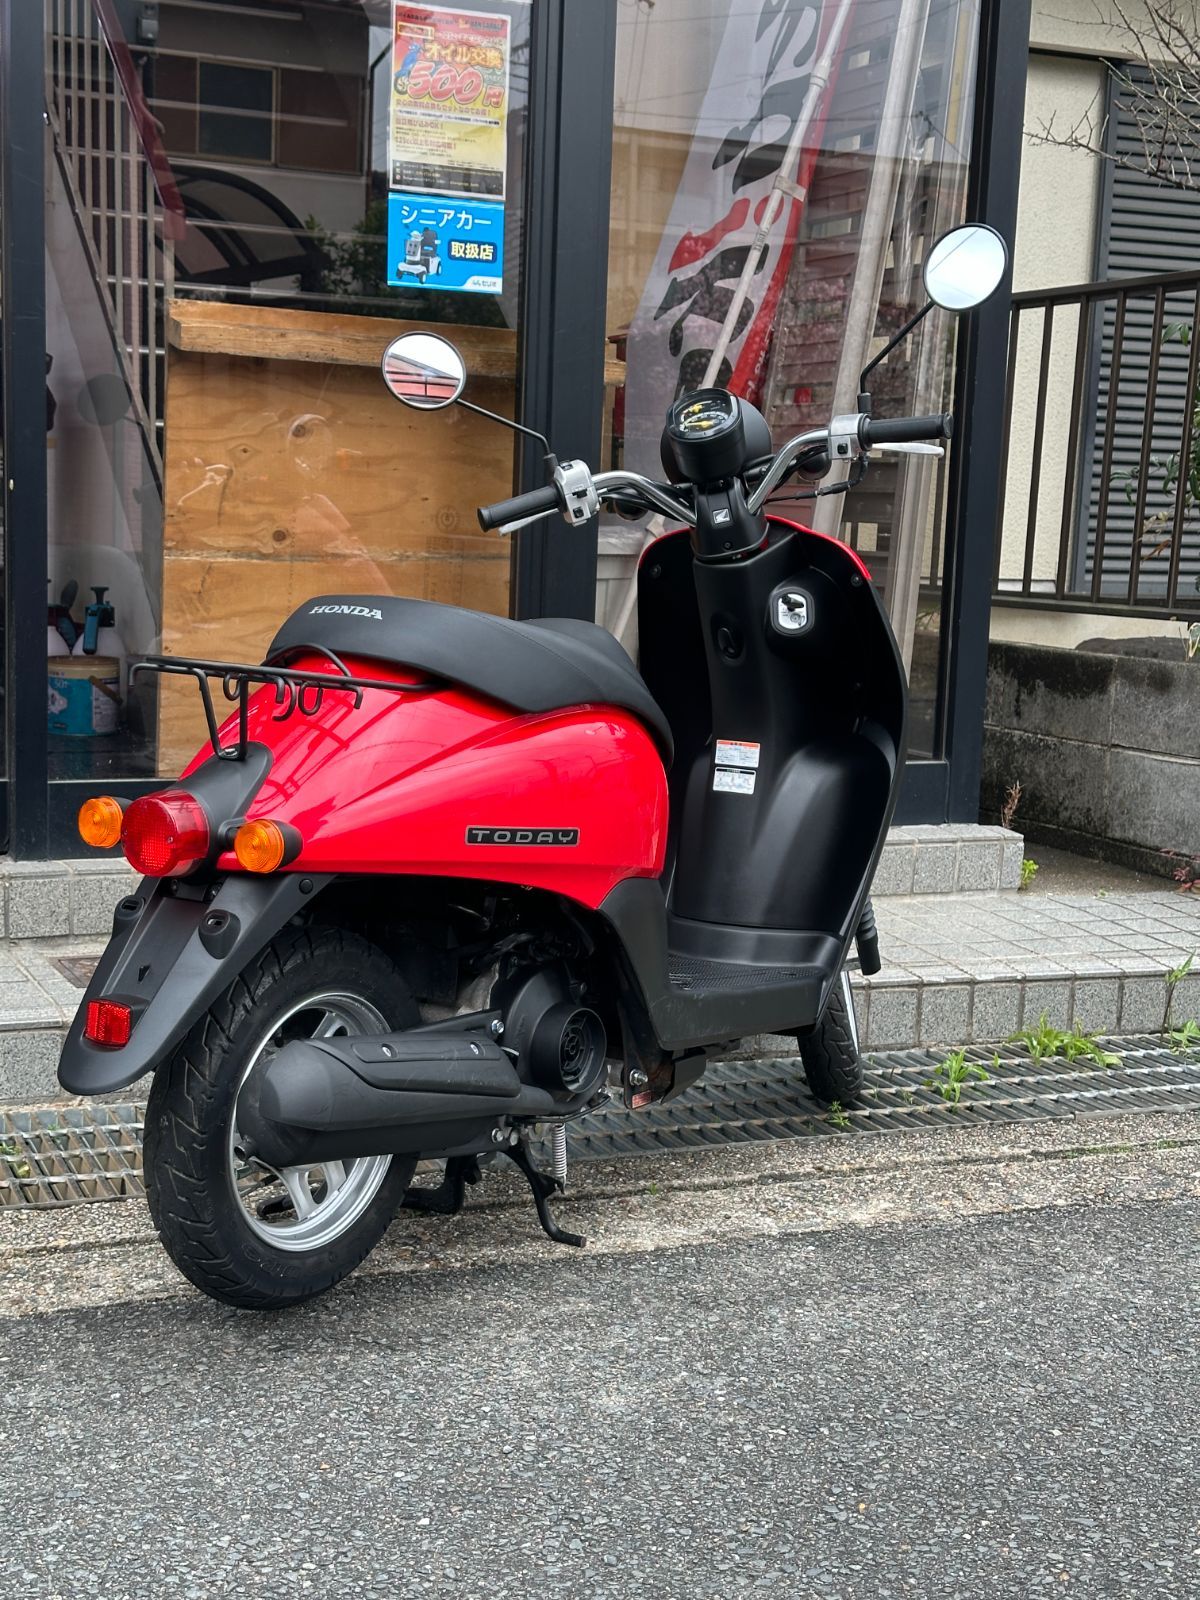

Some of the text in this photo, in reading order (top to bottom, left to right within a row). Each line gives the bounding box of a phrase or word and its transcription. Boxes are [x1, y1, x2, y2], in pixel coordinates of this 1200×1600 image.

[424, 42, 503, 69] オイル交換
[401, 205, 492, 230] シニアカー
[450, 241, 494, 261] 取扱店
[308, 604, 383, 620] HONDA
[471, 829, 574, 843] TODAY
